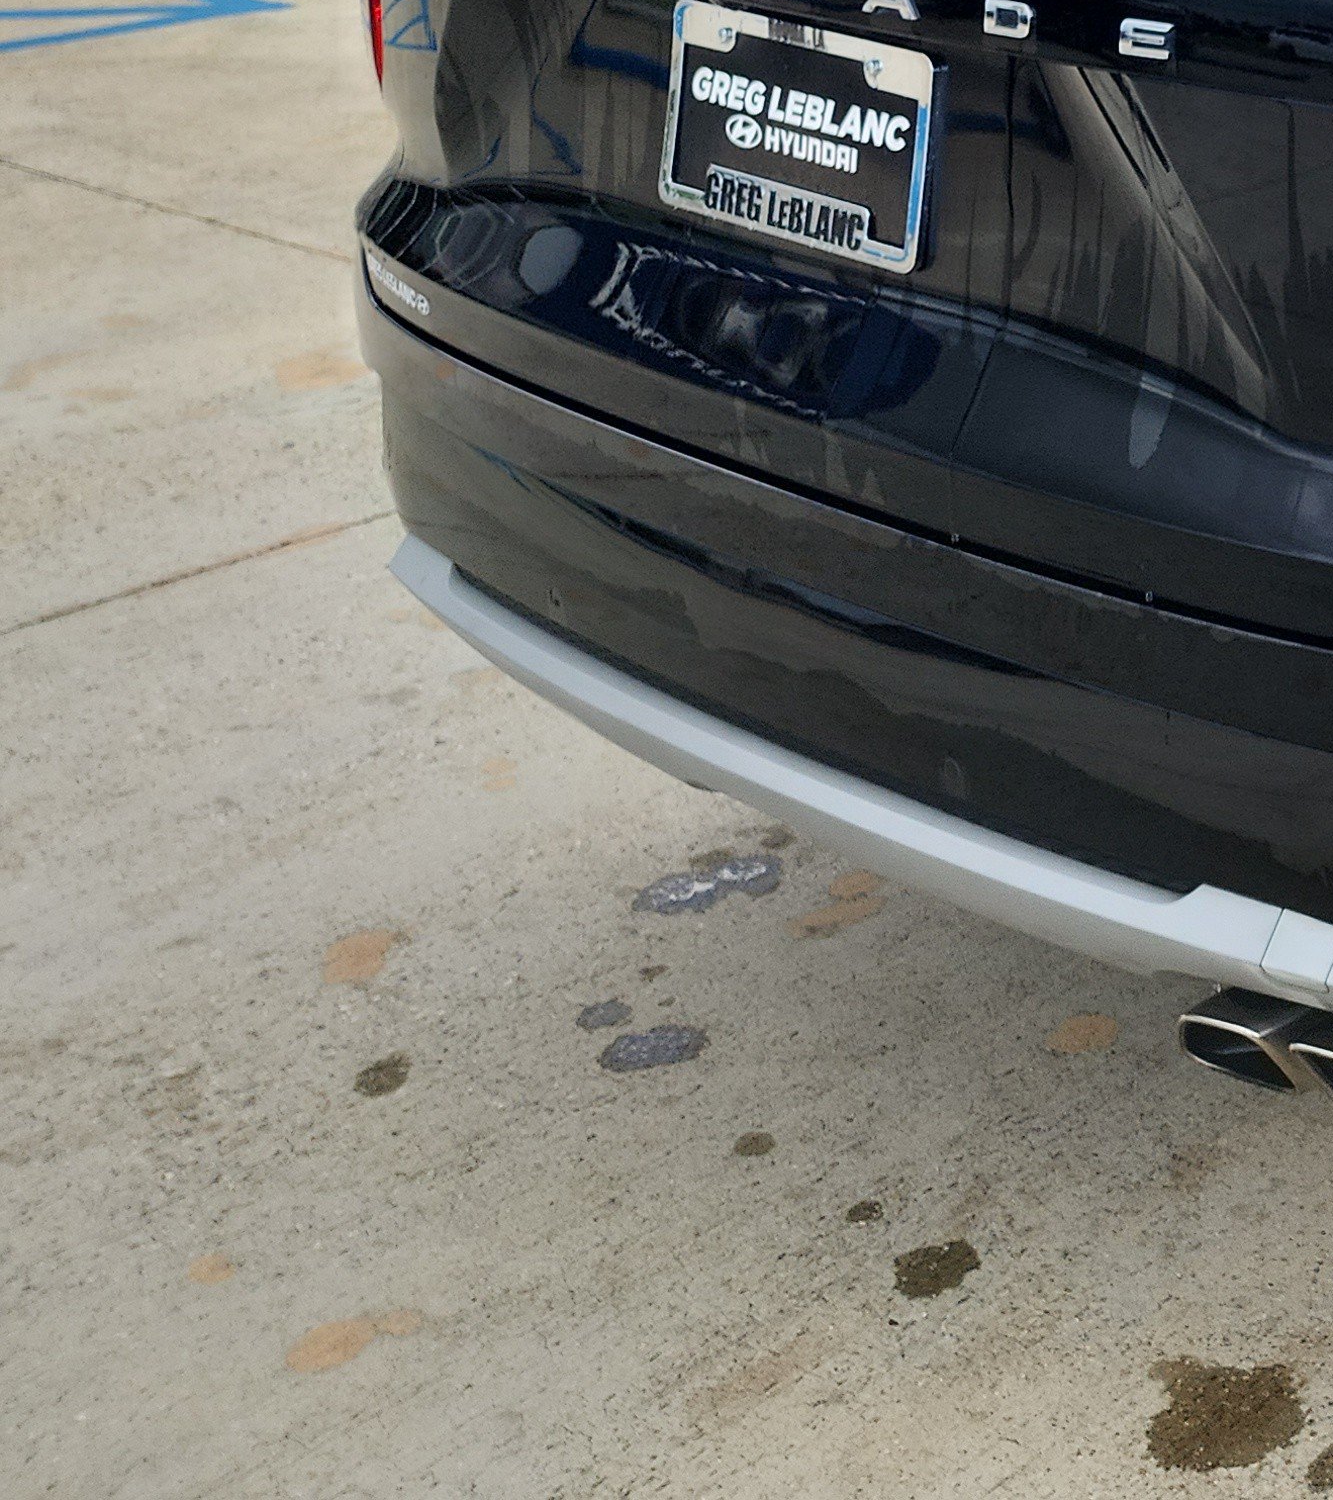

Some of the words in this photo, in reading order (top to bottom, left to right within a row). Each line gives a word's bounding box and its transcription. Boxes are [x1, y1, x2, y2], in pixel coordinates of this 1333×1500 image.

[691, 66, 766, 116] GREG
[767, 85, 911, 152] LEBLANC
[764, 125, 859, 174] HYUNDAI
[704, 171, 763, 223] GREG
